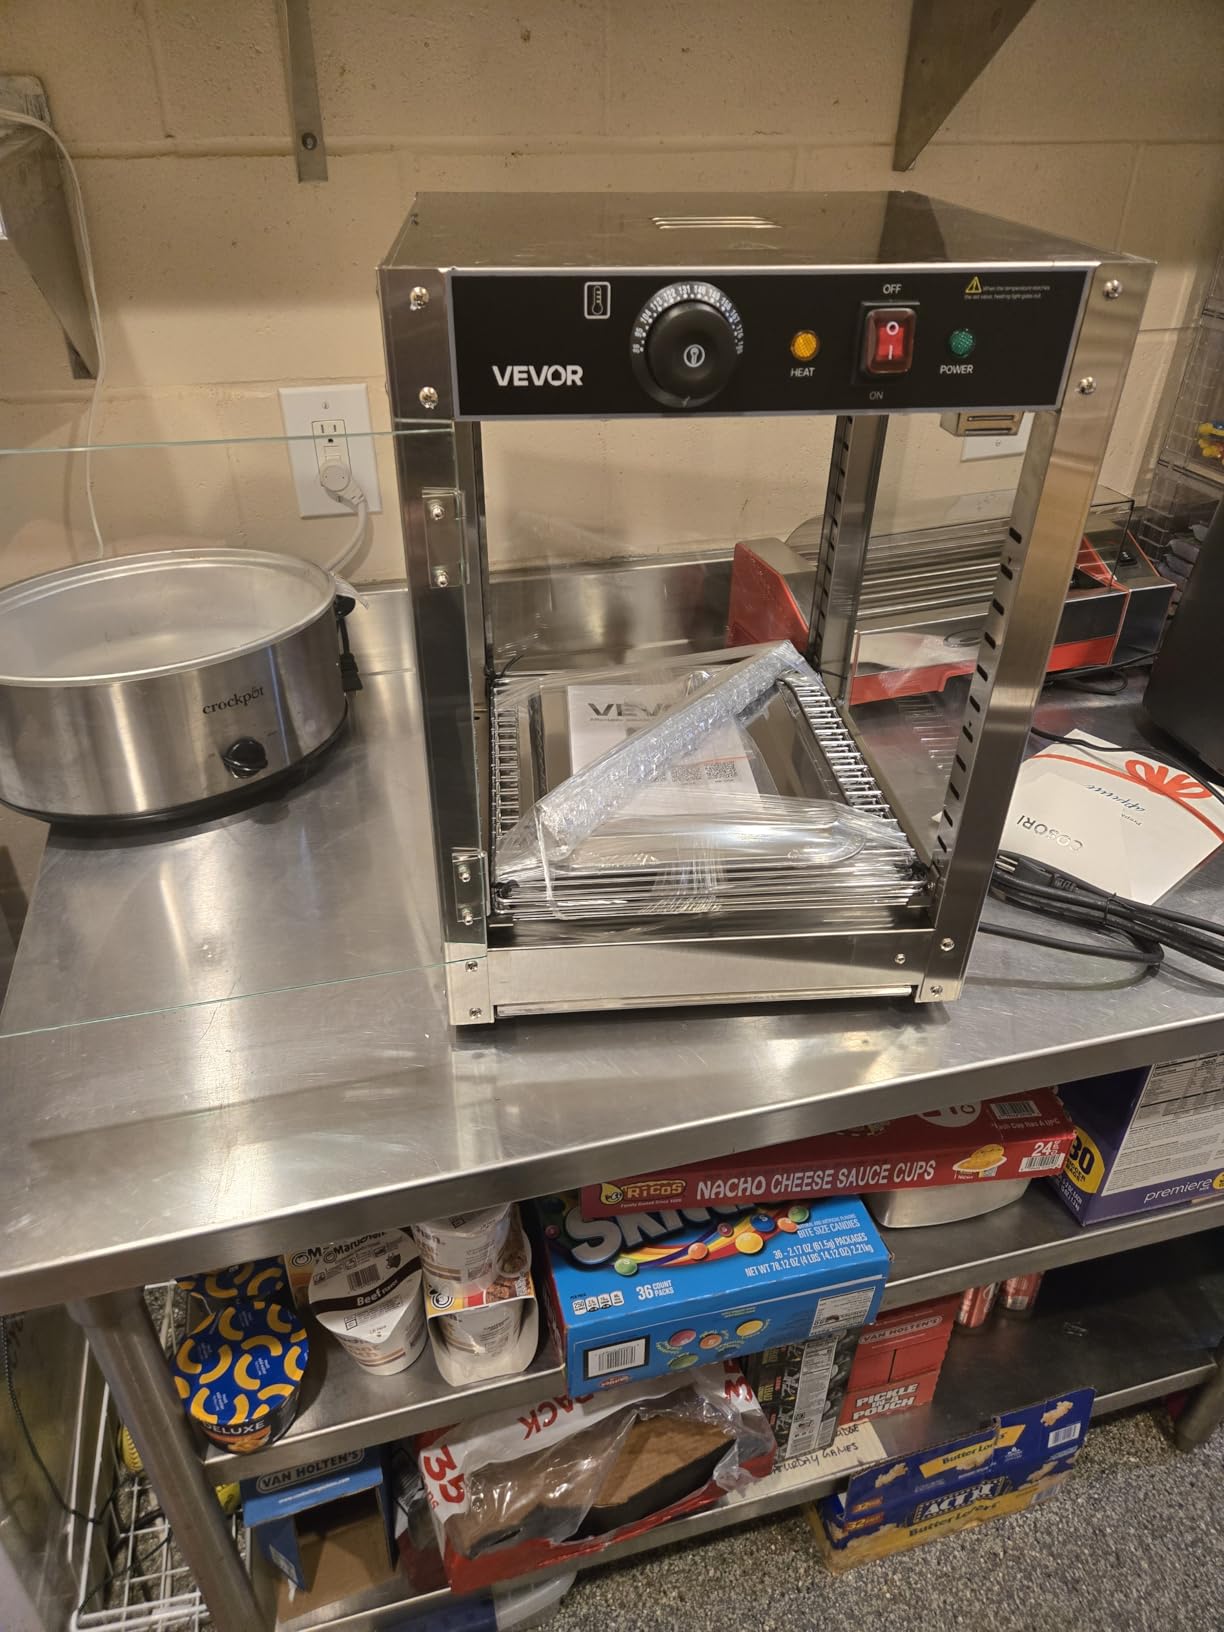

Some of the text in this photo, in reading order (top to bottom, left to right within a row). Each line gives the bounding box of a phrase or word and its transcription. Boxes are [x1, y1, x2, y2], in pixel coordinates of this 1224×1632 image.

[678, 284, 691, 294] 131
[882, 284, 902, 294] OFF
[492, 365, 584, 387] VEVOR
[790, 367, 815, 378] HEAT
[939, 364, 974, 375] POWER
[869, 391, 884, 400] ON
[1031, 1141, 1053, 1157] 24
[697, 1160, 936, 1200] NACHO CHEESE SAUCE CUPS
[1144, 1177, 1213, 1204] premiere
[797, 1219, 860, 1239] BITE SIZE CANDIES
[787, 1246, 804, 1256] 2.17
[804, 1244, 813, 1252] OZ
[835, 1232, 868, 1246] PACKAGES
[745, 1266, 758, 1277] NET
[758, 1263, 771, 1274] WT
[771, 1259, 790, 1271] 78.12
[790, 1257, 800, 1267] OZ
[808, 1253, 820, 1263] LBS
[356, 1290, 381, 1306] Beef
[636, 1284, 654, 1301] 36
[652, 1280, 672, 1290] COUNT
[654, 1286, 674, 1297] PACKS
[863, 1332, 886, 1343] VAN
[889, 1317, 939, 1336] HOLTEN'S
[856, 1383, 918, 1408] PICKLE
[517, 1393, 594, 1440] ACK
[853, 1396, 915, 1421] POUCH
[822, 1442, 860, 1459] GAMES
[941, 1448, 977, 1465] Butter
[263, 1449, 359, 1488] VAN HOLTEN'S
[423, 1445, 465, 1504] 35
[922, 1493, 968, 1517] ACT
[909, 1515, 955, 1537] Butter
